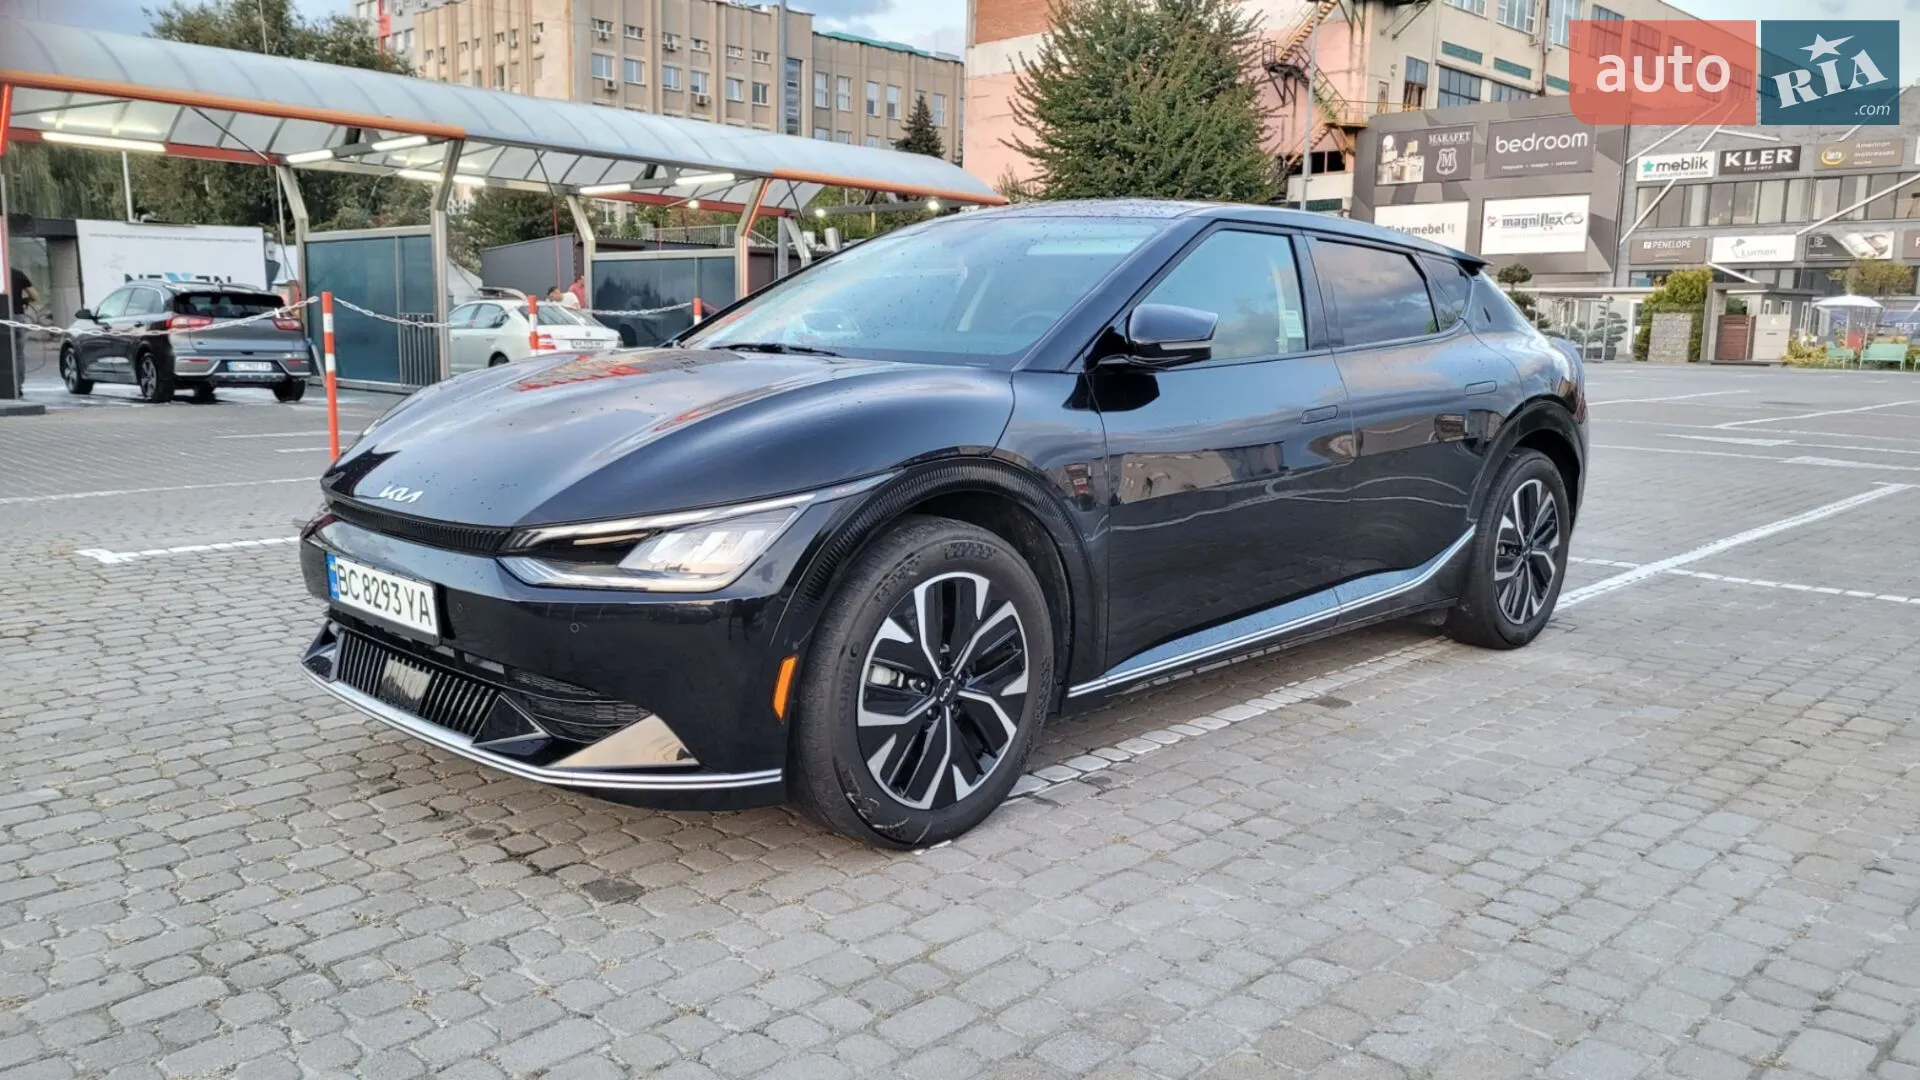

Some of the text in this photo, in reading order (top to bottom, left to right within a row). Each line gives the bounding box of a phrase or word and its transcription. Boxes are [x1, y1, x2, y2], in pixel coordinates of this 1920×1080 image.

[1428, 131, 1471, 144] MARAFET
[1495, 132, 1588, 153] bedroom
[1656, 156, 1709, 172] meblik
[1724, 148, 1794, 167] KLER
[1502, 213, 1564, 229] magniflex
[1652, 240, 1692, 249] PENELOPE
[336, 564, 432, 626] BC 8293 YA
